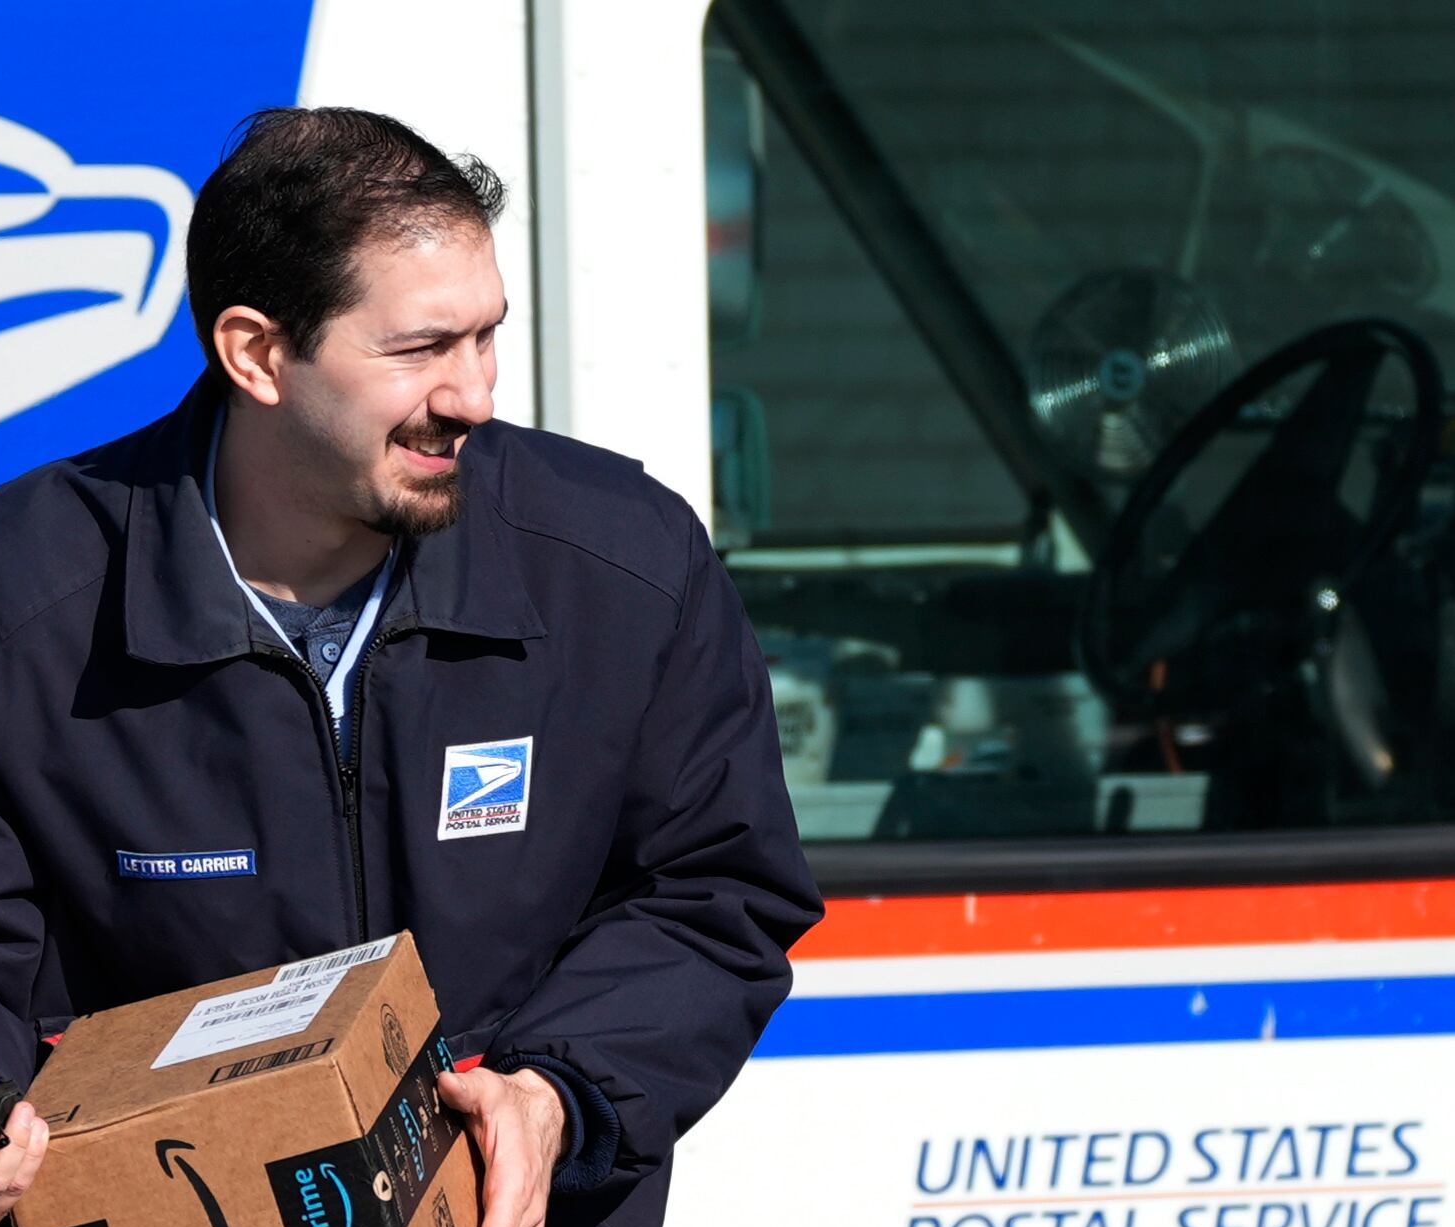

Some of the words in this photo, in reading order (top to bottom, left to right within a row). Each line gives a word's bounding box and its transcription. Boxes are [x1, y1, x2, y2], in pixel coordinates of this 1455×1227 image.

[445, 820, 482, 832] POSTAL
[484, 814, 521, 827] SERVICE
[447, 808, 483, 820] UNITED
[124, 857, 176, 873] LETTER
[181, 855, 249, 873] CARRIER
[914, 1130, 1173, 1195] UNITED
[1186, 1120, 1423, 1184] STATES
